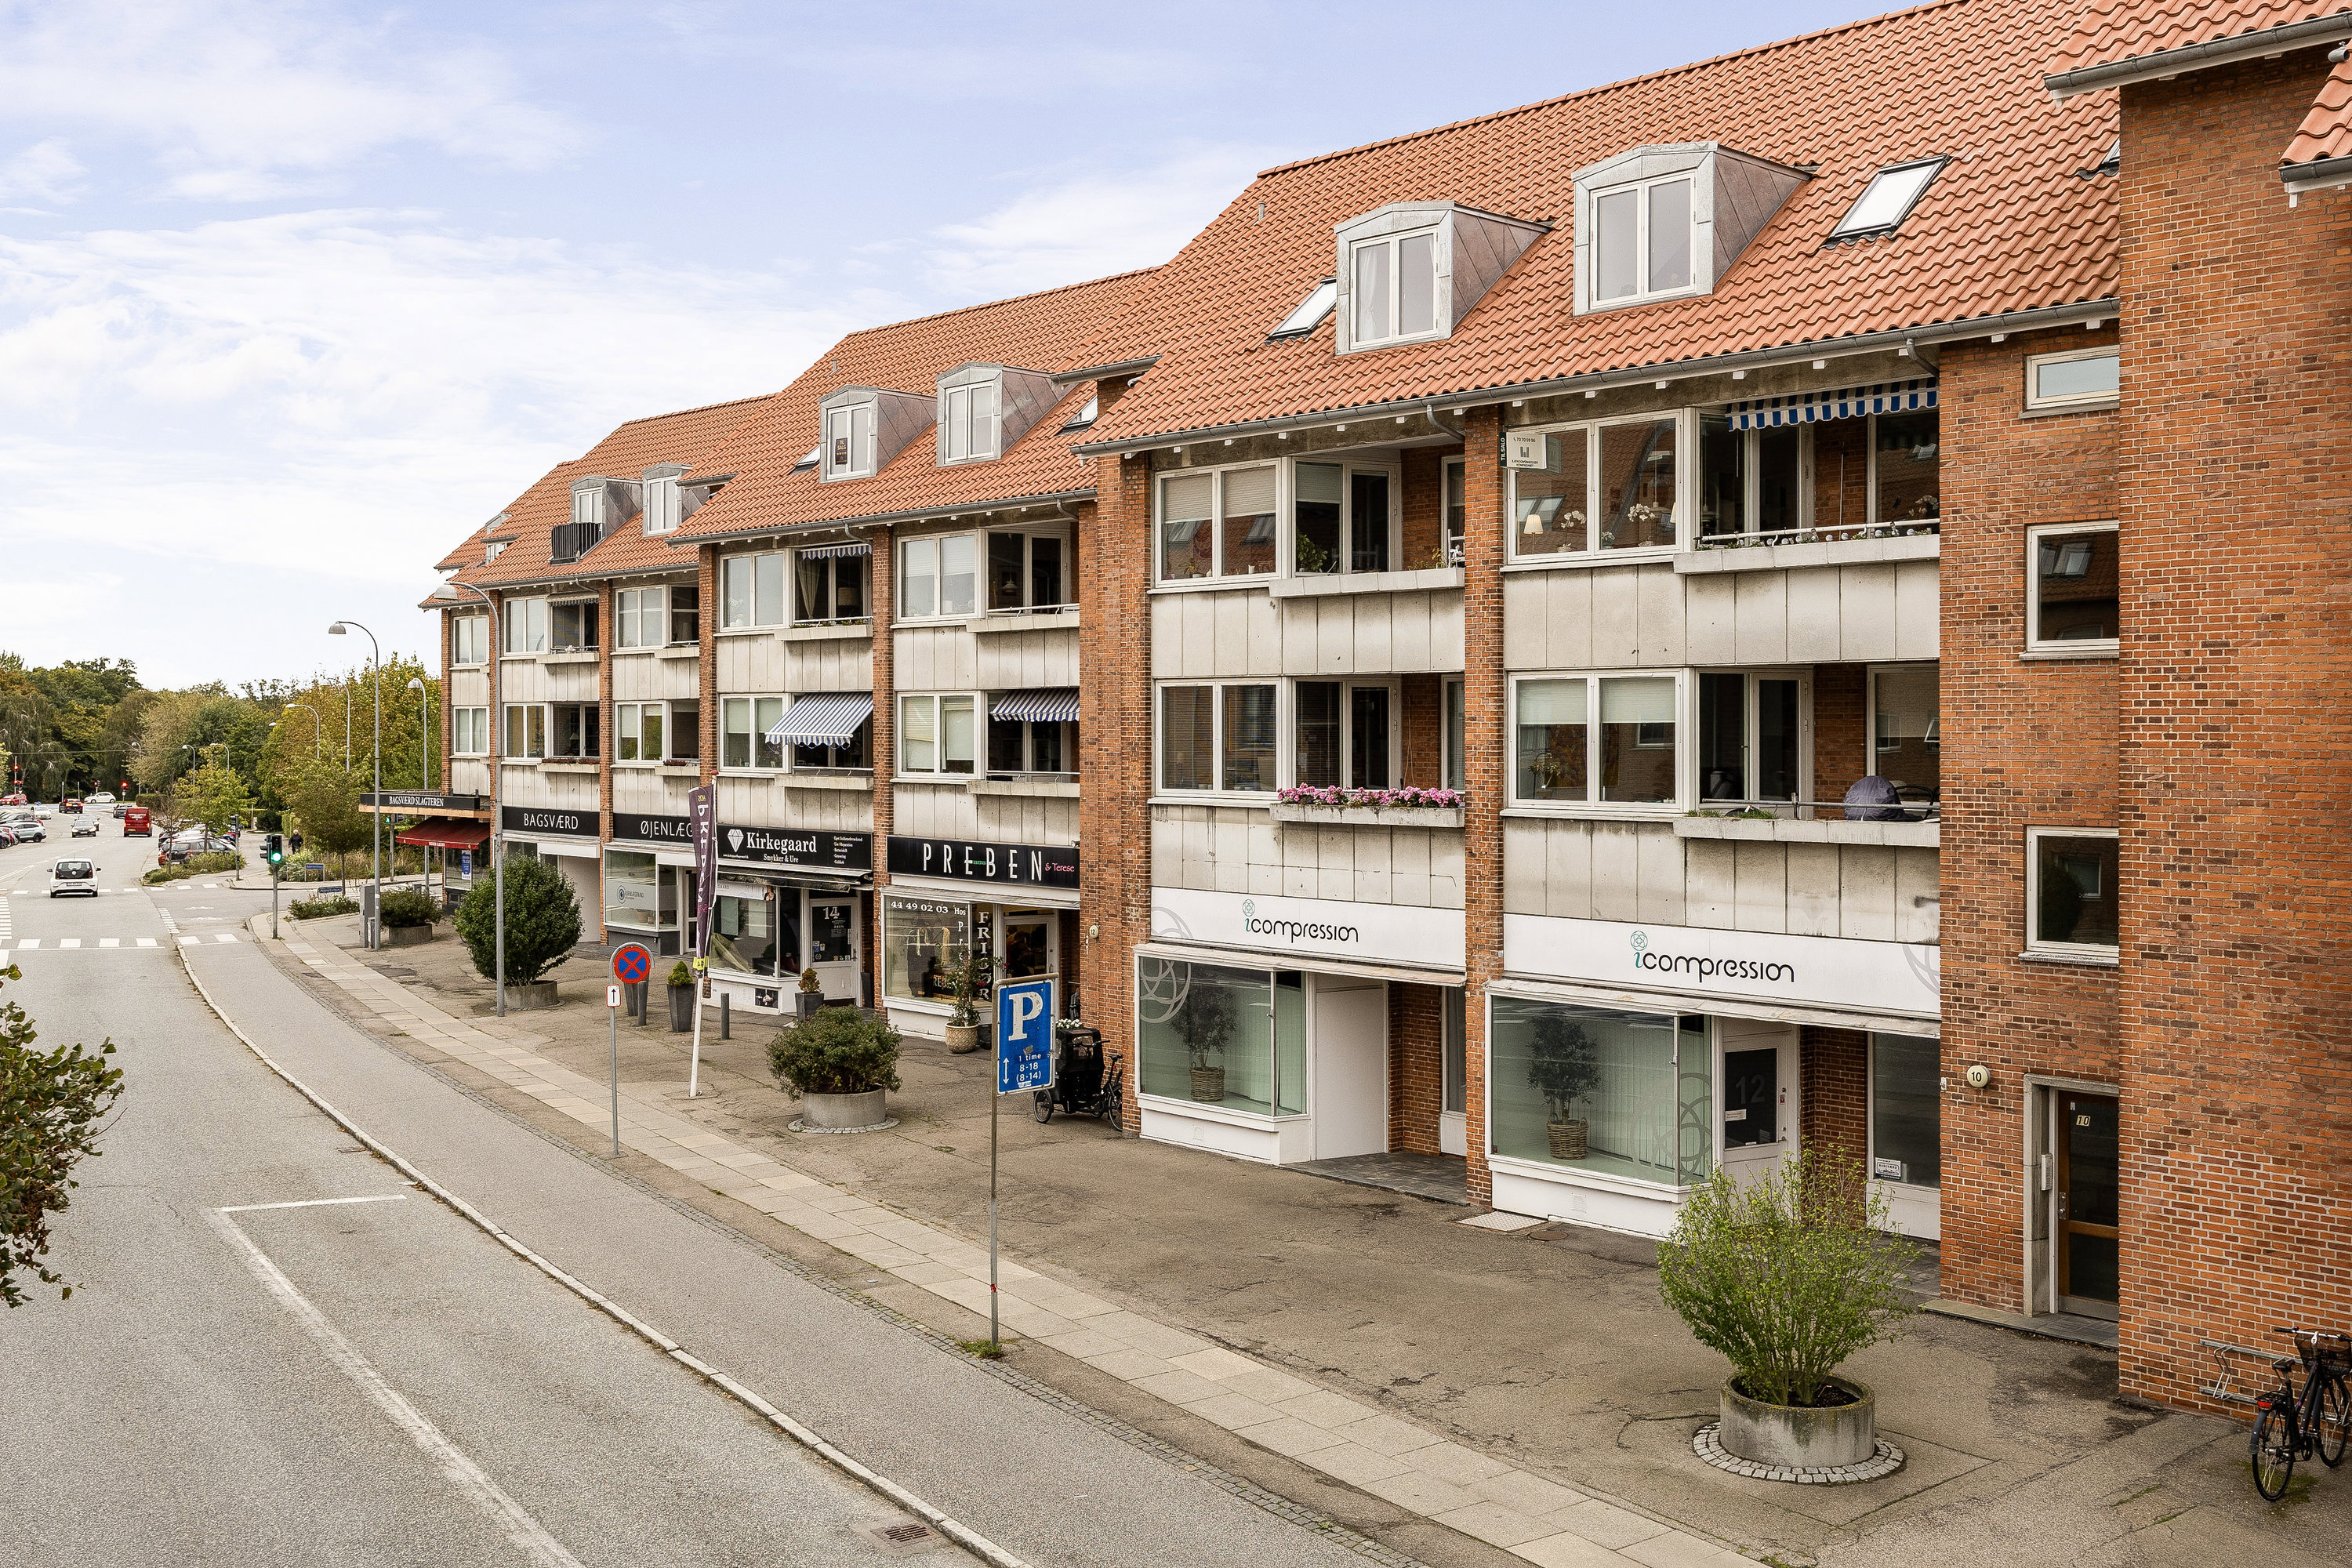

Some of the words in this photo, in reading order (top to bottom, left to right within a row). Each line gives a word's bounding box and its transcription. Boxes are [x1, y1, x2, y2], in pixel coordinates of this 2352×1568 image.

[389, 796, 415, 805] BAGSVÆRD
[416, 797, 444, 807] SLAGTEREN
[524, 813, 579, 830] BAGSVÆRD
[641, 820, 693, 838] ØJENLÆG
[746, 832, 817, 855] Kirkegaard
[764, 853, 784, 862] Smykker
[789, 855, 799, 863] Ure
[923, 843, 1042, 881] PREBEN
[1044, 862, 1051, 871] &
[1052, 862, 1075, 872] Terese
[822, 906, 840, 920] 14
[920, 904, 934, 913] 02
[935, 906, 949, 914] 03
[954, 907, 967, 916] Hos
[1245, 917, 1359, 944] icompression
[1633, 951, 1795, 983] icompression
[1008, 991, 1044, 1041] P
[1025, 1053, 1042, 1062] time
[1971, 1071, 1983, 1083] 10
[1735, 1074, 1766, 1105] 12
[2078, 1116, 2089, 1126] 10
